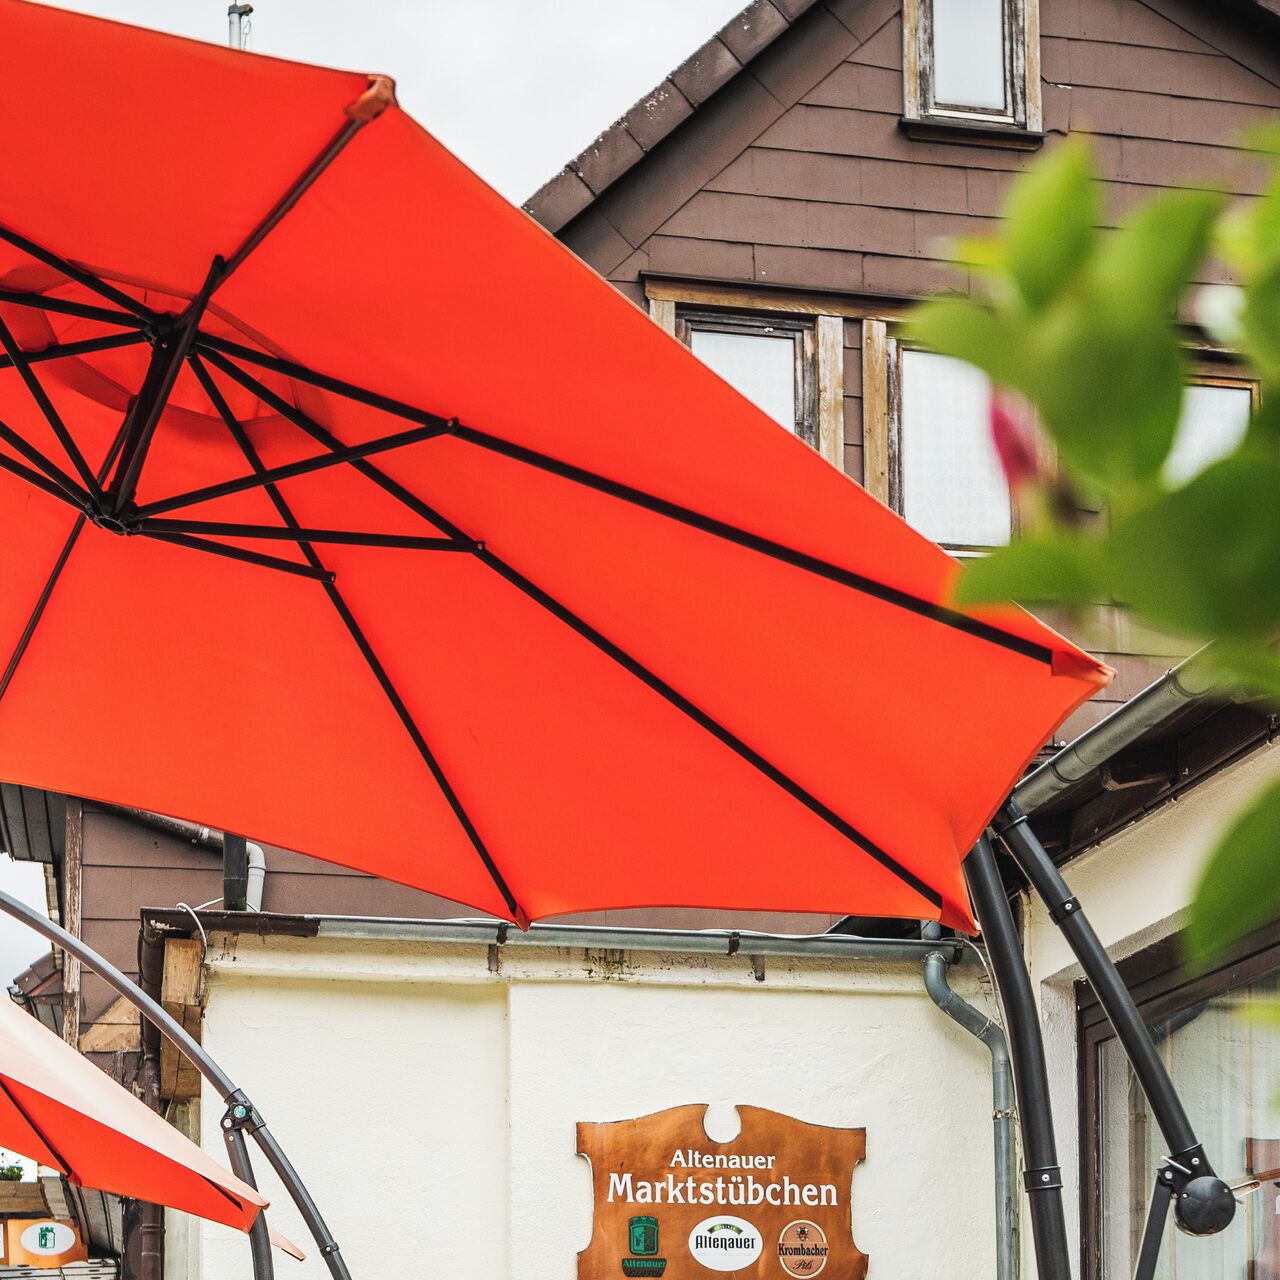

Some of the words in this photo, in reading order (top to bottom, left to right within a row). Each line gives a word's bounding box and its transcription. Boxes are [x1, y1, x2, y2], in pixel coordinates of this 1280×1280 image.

[670, 1149, 775, 1169] Altenauer
[607, 1173, 838, 1206] Marktstübchen
[695, 1235, 756, 1251] Altenauer
[778, 1243, 829, 1256] Krombacher
[623, 1259, 667, 1268] Altenauer
[793, 1260, 814, 1270] Pils
